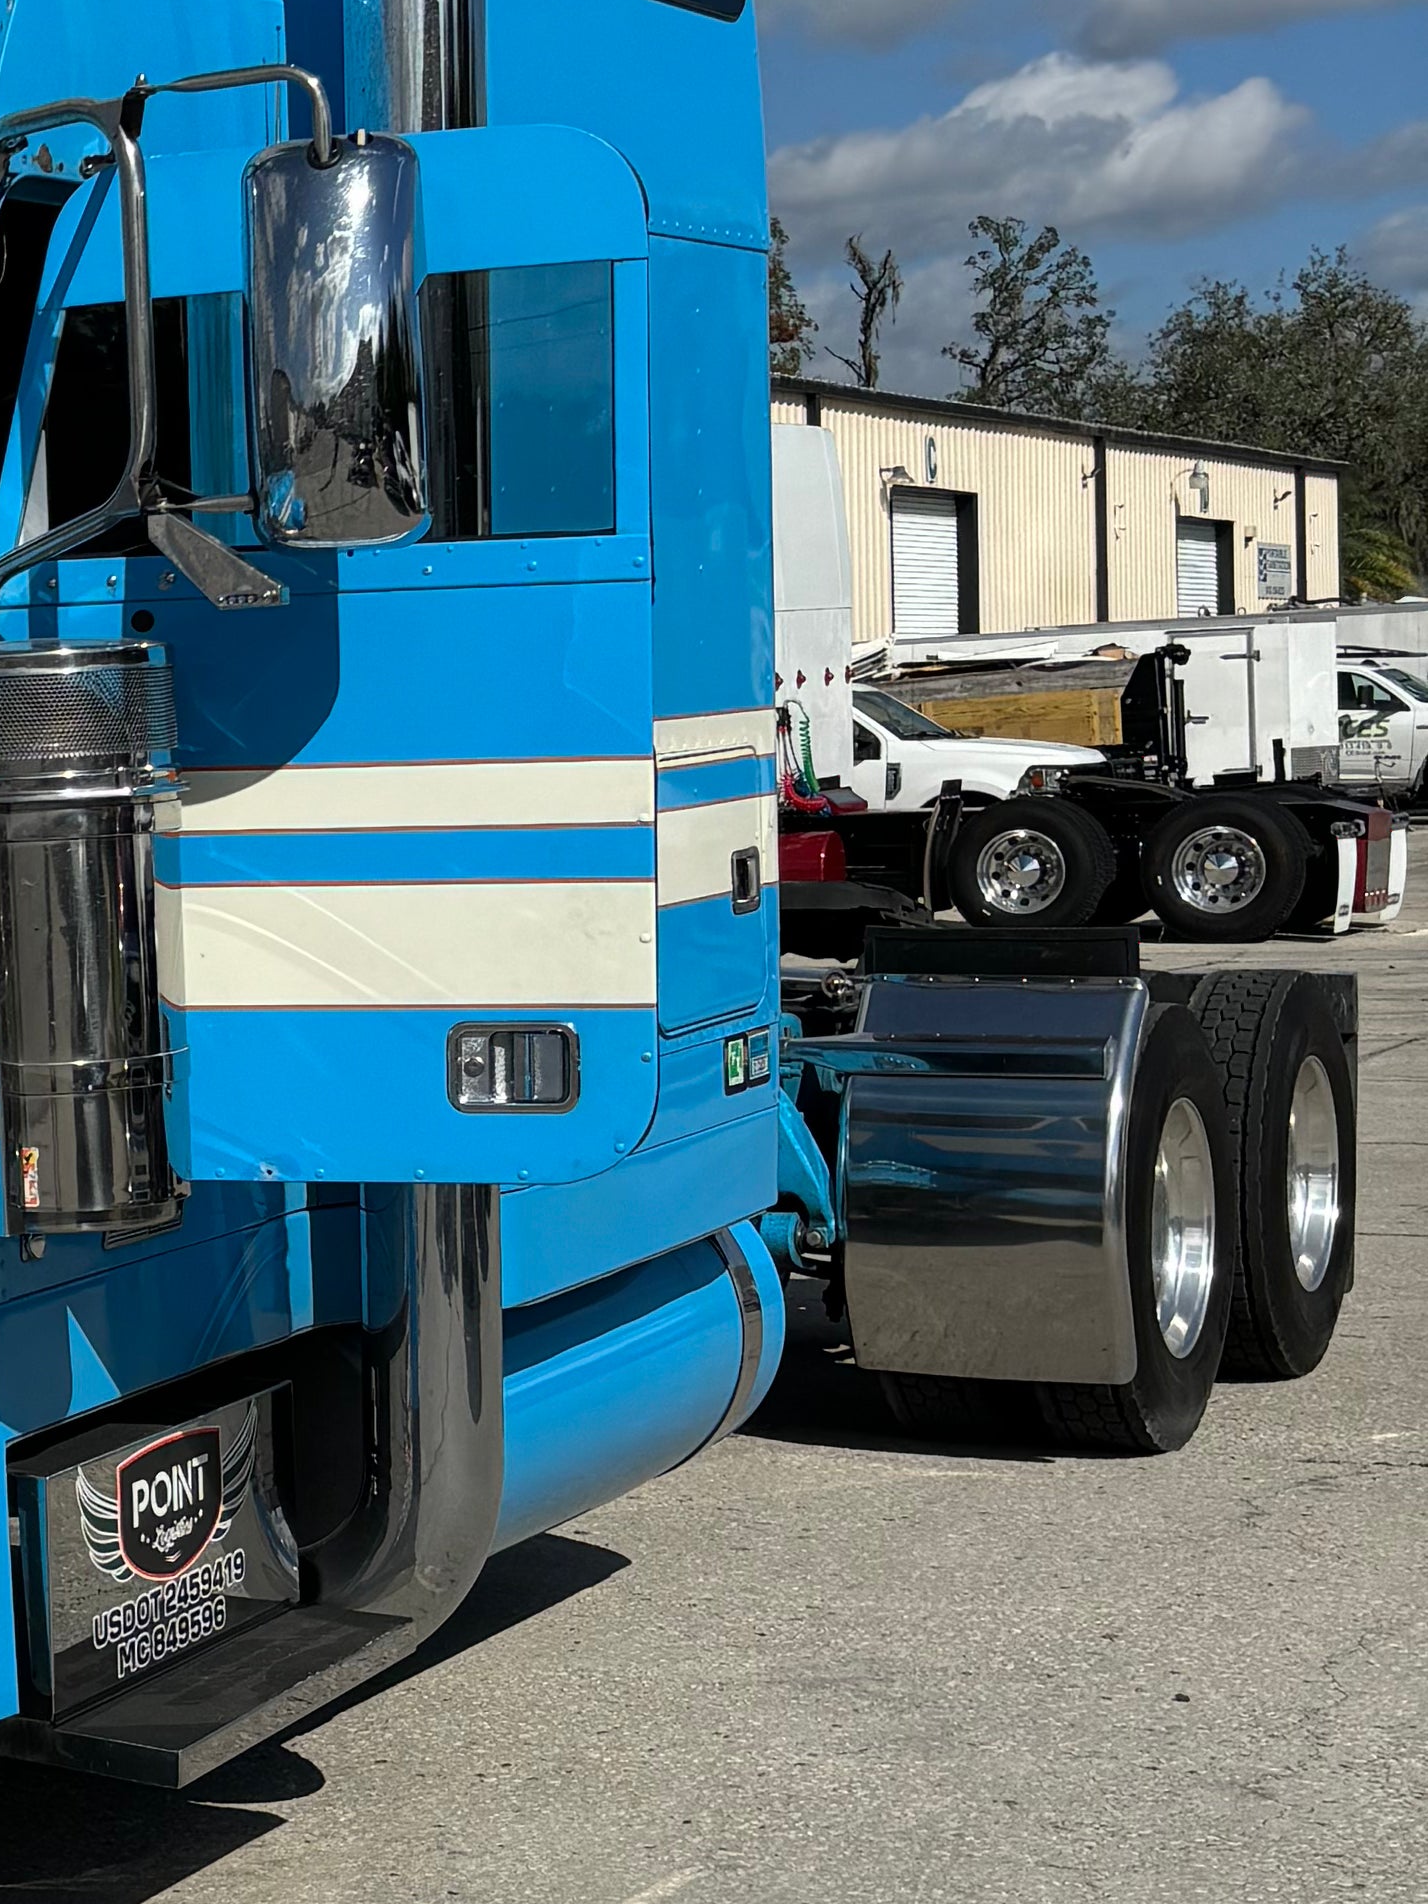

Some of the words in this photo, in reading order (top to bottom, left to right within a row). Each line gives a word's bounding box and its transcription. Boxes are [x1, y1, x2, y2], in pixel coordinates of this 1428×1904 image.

[131, 1453, 208, 1528] POINT
[92, 1585, 163, 1649] USDOT
[164, 1548, 245, 1617] 2459419
[117, 1632, 151, 1678] MC
[152, 1595, 227, 1660] 849596
